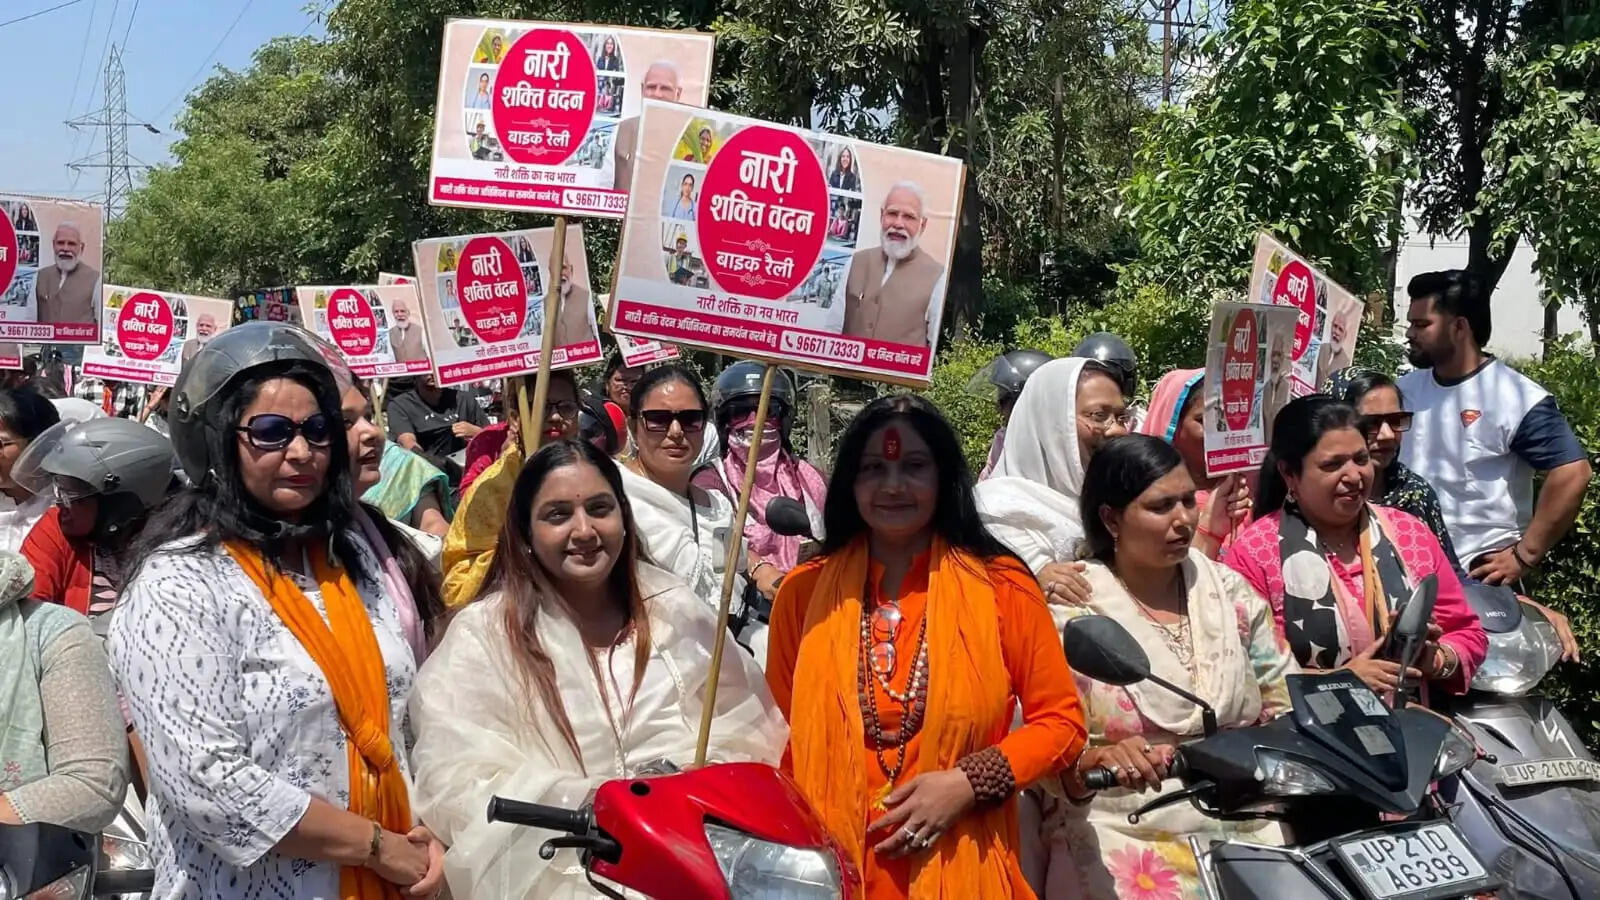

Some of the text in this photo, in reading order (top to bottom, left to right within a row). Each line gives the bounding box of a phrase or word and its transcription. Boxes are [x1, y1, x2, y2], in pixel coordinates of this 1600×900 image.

[523, 41, 571, 80] नारी
[501, 80, 586, 111] शक्ति वंदन
[508, 127, 571, 147] बाइक रैली
[493, 165, 576, 184] नारी शक्ति का नव भारत
[740, 146, 798, 194] नारी
[575, 192, 602, 207] 96671
[710, 189, 815, 235] शक्ति वंदन
[470, 245, 502, 277] नारी
[716, 250, 794, 279] बाइक रैली
[463, 277, 519, 304] शक्ति वंदन
[1287, 272, 1308, 303] नारी
[134, 300, 160, 319] नारी
[336, 294, 359, 314] नारी
[697, 294, 799, 324] नारी शक्ति का नव भारत
[7, 325, 28, 336] 96671
[30, 326, 51, 337] 73333
[122, 318, 168, 336] शक्ति वंदन
[476, 311, 517, 330] बाइक रैली
[625, 309, 641, 323] नारी
[642, 312, 659, 325] शक्ति
[660, 314, 676, 328] वंदन
[711, 324, 722, 335] का
[796, 335, 826, 353] 96671
[828, 340, 860, 359] 73333
[1233, 320, 1251, 354] नारी
[1317, 682, 1353, 691] SUZUKI
[1517, 764, 1536, 780] UP
[1362, 830, 1449, 863] UP 21D
[1385, 853, 1470, 890] A6399
